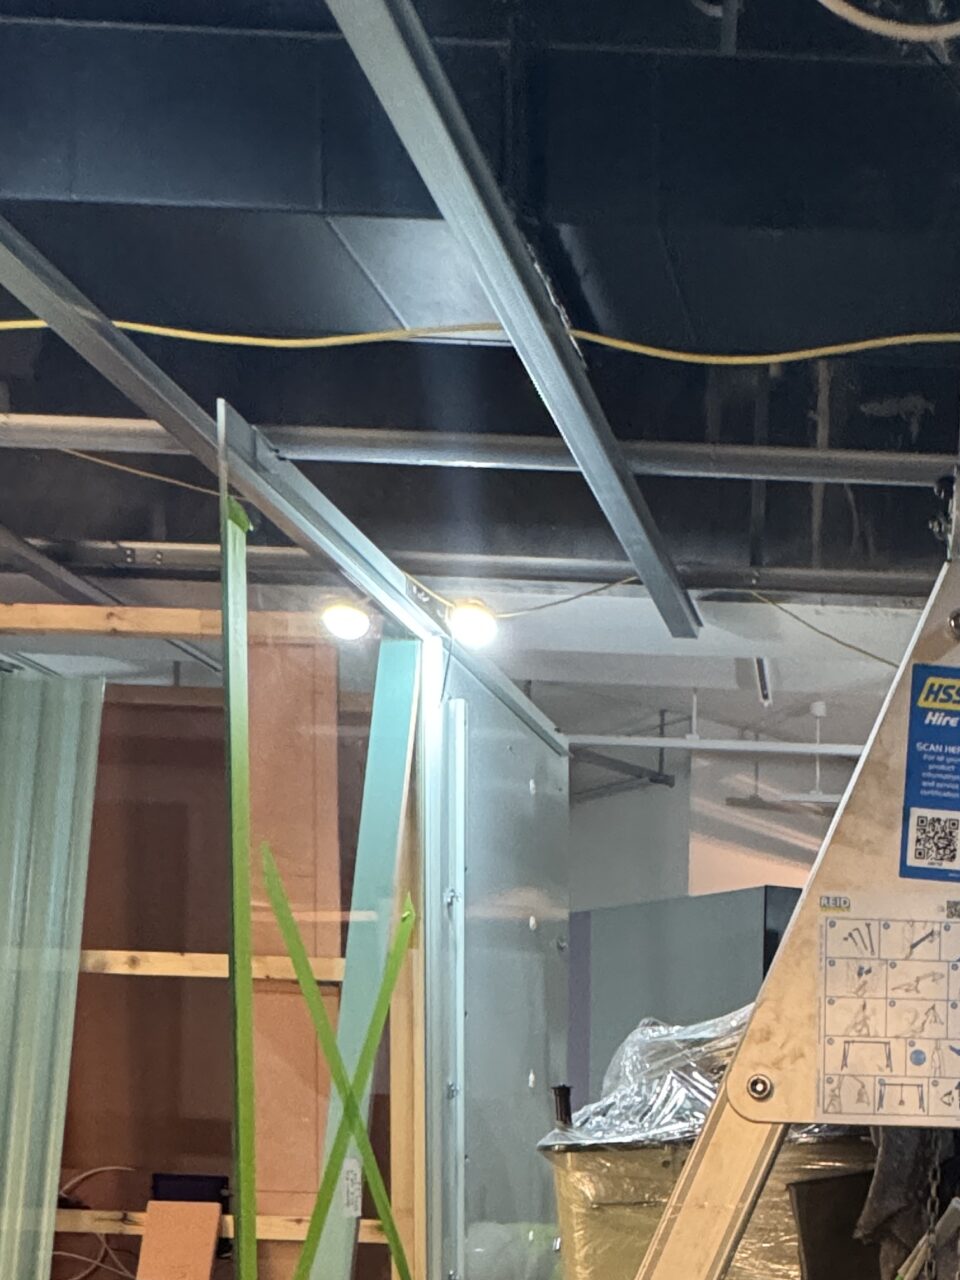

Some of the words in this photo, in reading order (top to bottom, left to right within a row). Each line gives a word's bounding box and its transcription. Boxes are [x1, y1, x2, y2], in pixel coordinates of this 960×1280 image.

[924, 711, 960, 727] Hire
[916, 742, 943, 753] SCAN
[820, 896, 850, 908] REID
